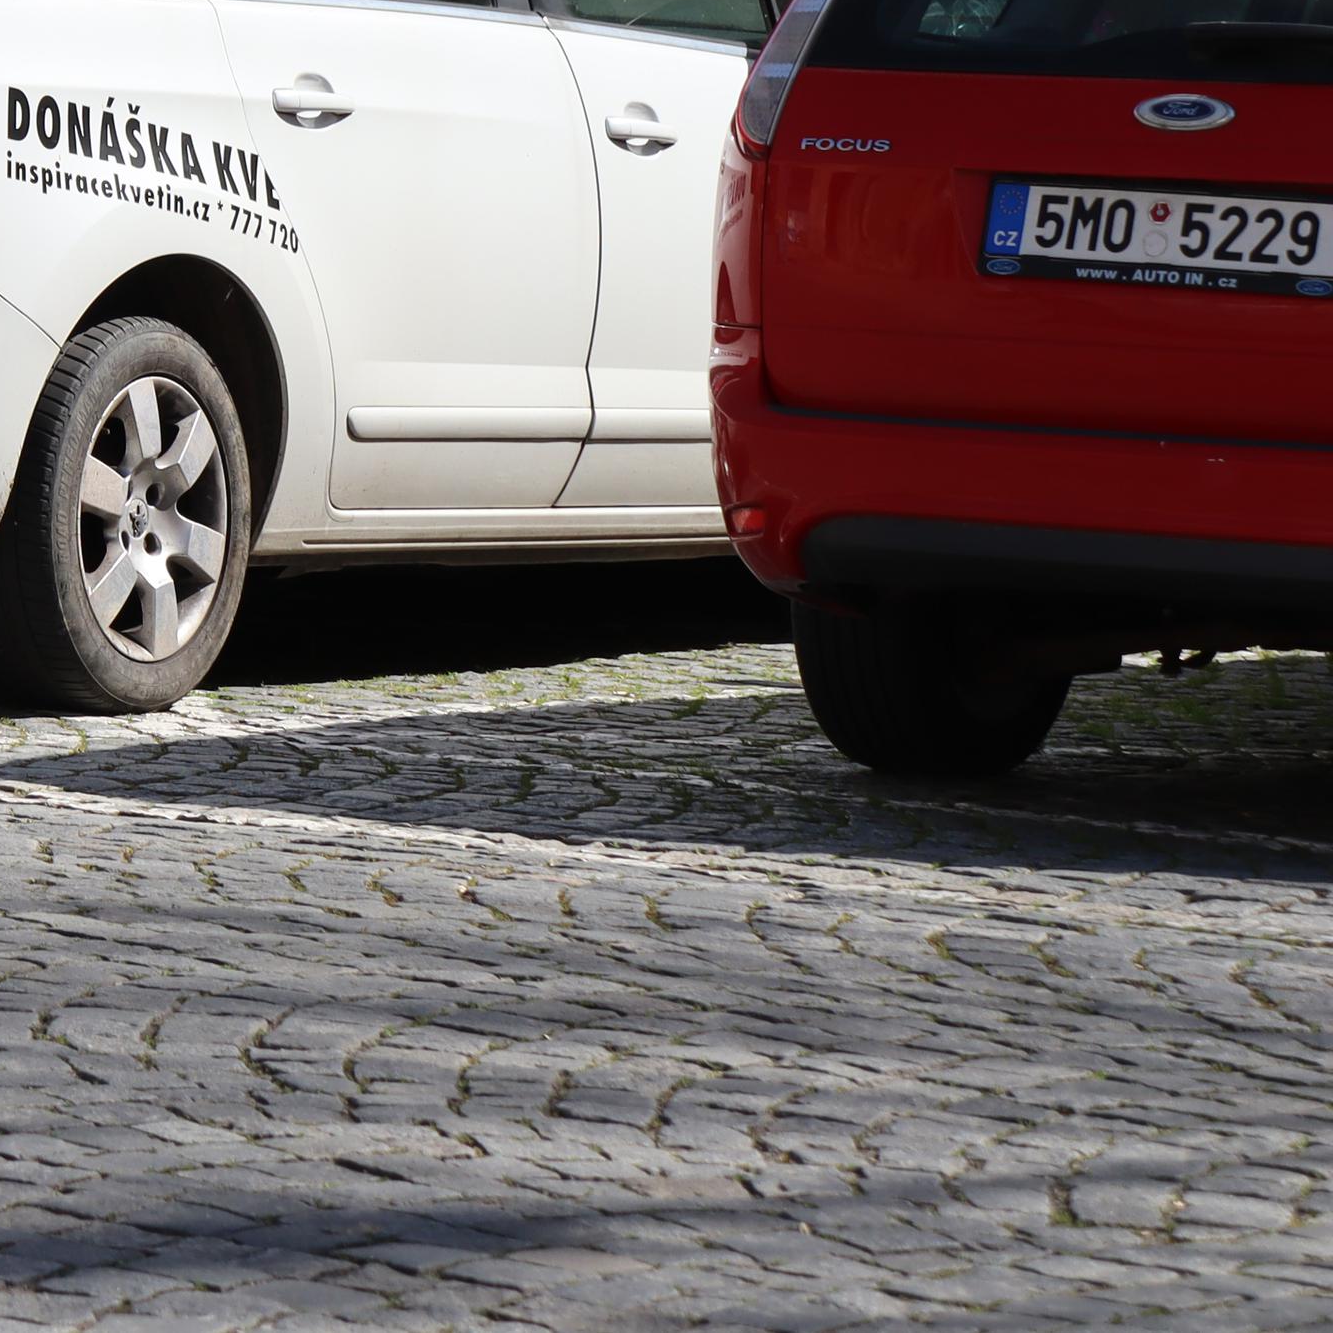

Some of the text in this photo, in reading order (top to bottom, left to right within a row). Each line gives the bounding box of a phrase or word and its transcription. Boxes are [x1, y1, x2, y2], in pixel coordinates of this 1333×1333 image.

[1162, 100, 1199, 116] Ford
[6, 85, 207, 185] DONÁŠKA
[800, 137, 891, 153] FOCUS
[6, 150, 300, 254] inspiracekvetin.cz 777 720
[992, 229, 1018, 247] CZ
[1179, 203, 1320, 266] 5229
[1132, 269, 1181, 284] AUTO
[1184, 272, 1204, 286] IN
